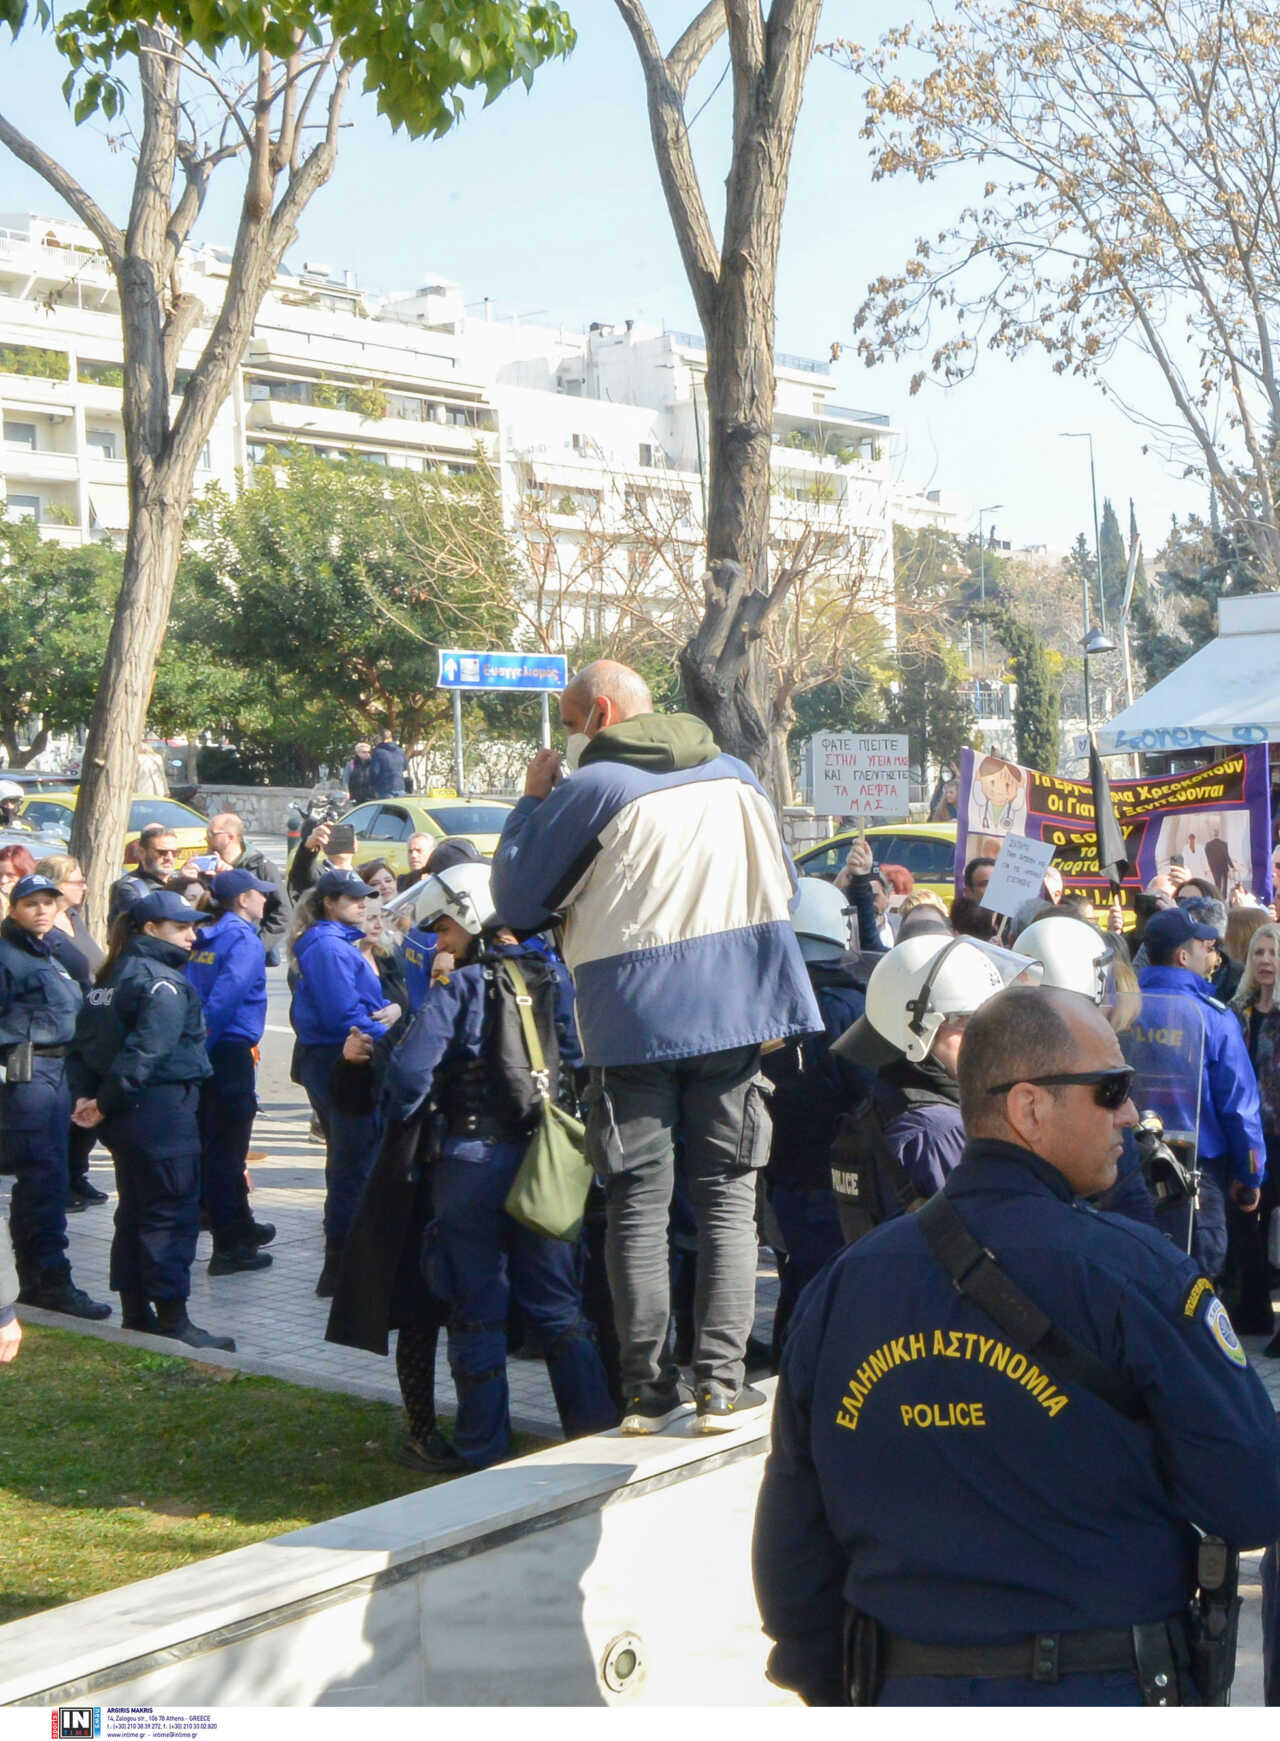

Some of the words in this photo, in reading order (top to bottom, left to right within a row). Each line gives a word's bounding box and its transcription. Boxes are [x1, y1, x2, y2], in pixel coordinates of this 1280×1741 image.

[821, 738, 852, 752] ΦΑΤΕ
[825, 753, 857, 767] ΣΤΗΝ
[824, 769, 841, 781] ΚΑΙ
[833, 784, 849, 797] ΤΑ
[836, 1331, 926, 1430] ΕΛΛΗΝΙΚΗ
[932, 1329, 1069, 1418] ΑΣΤΥΝΟΜΙΑ
[901, 1402, 986, 1427] POLICE
